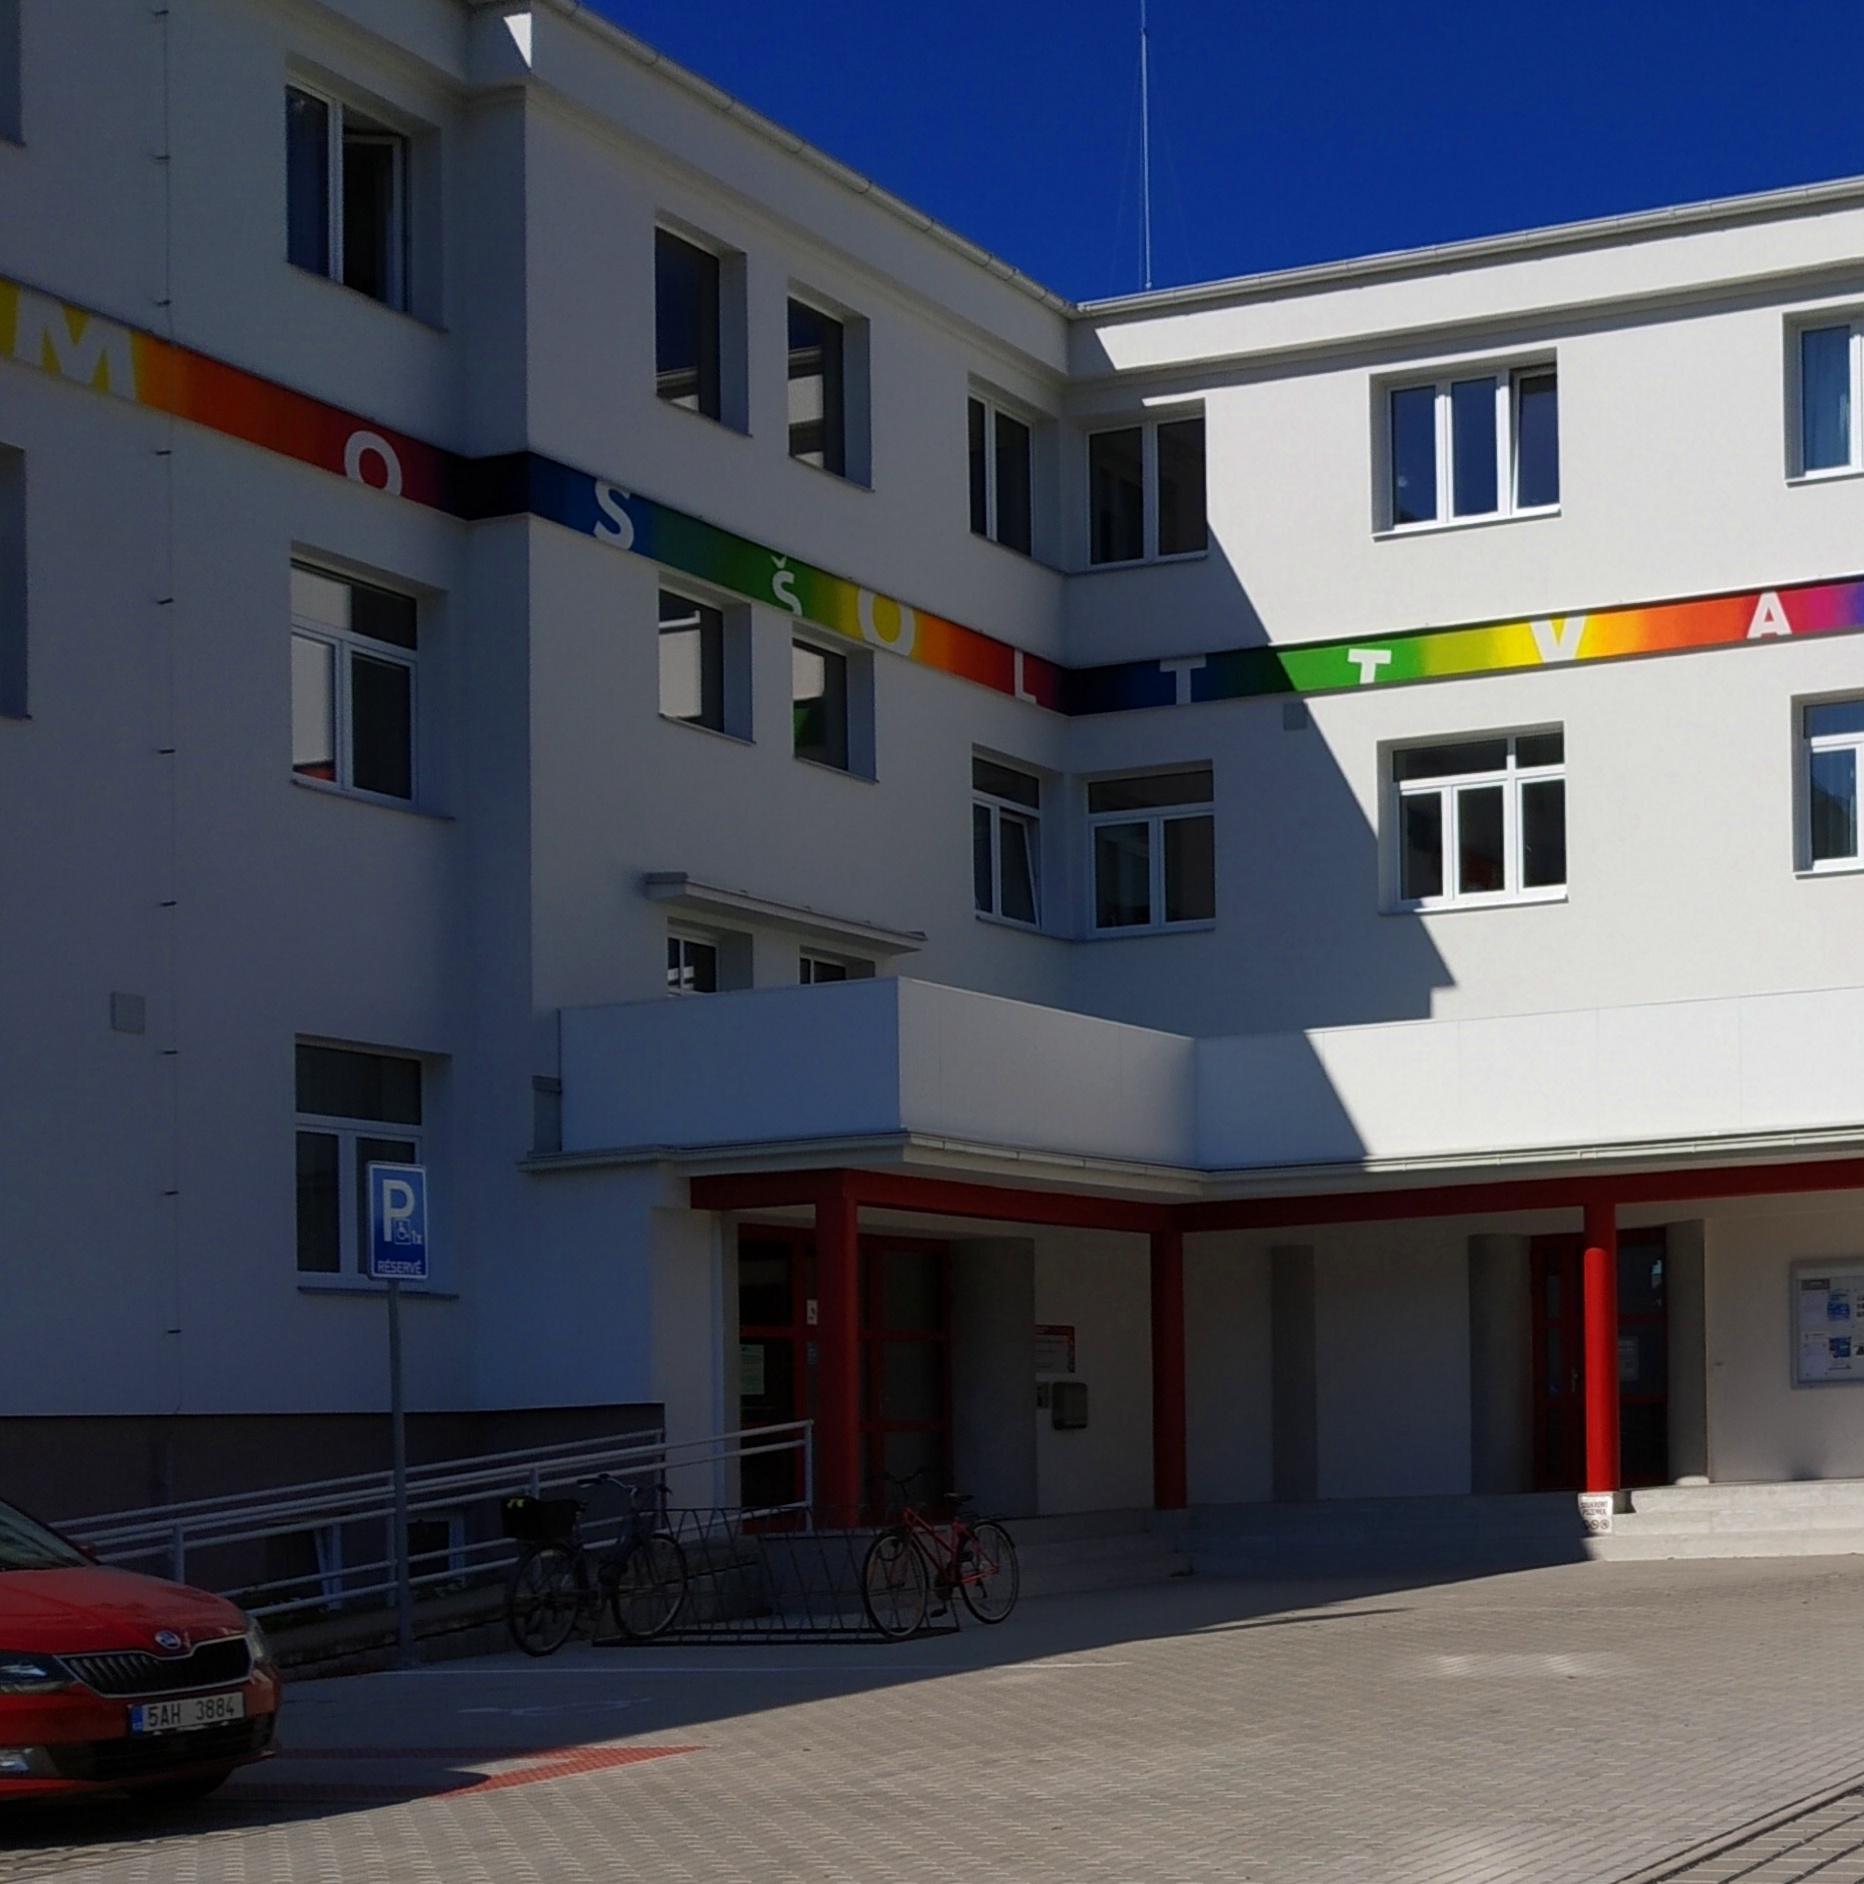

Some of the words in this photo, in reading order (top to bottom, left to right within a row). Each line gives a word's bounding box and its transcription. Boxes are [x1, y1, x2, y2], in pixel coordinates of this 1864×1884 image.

[593, 478, 636, 551] S
[1529, 614, 1587, 663] V
[1746, 591, 1793, 639] A
[1159, 655, 1208, 705] T
[1347, 648, 1391, 684] T
[383, 1179, 415, 1242] P
[148, 1703, 181, 1727] 5AH
[196, 1696, 234, 1721] 3884
